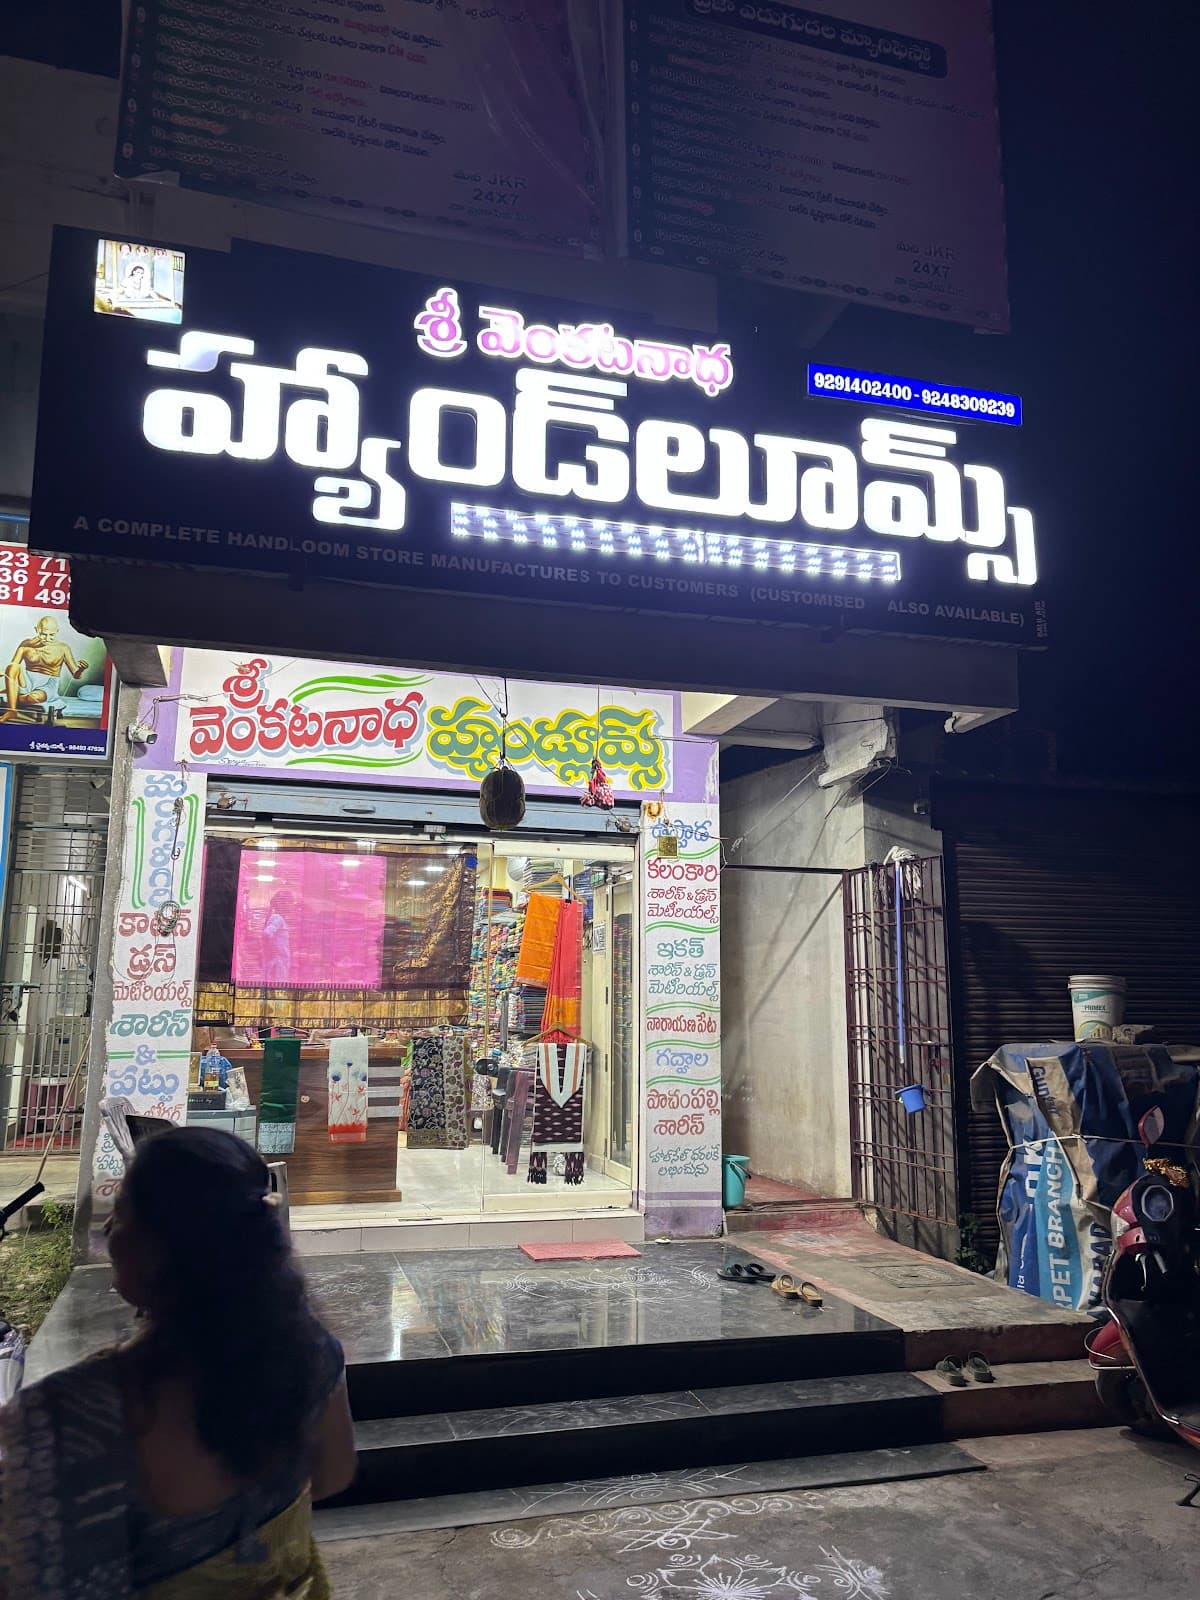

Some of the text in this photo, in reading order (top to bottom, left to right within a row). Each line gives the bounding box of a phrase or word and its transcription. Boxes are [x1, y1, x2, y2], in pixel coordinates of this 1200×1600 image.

[414, 286, 468, 358] శ్రీ
[813, 371, 912, 401] 9291402400
[921, 389, 1016, 418] 9248309239
[74, 516, 90, 531] A
[98, 518, 220, 544] COMPLETE
[227, 532, 350, 558] HANDLOOM
[356, 546, 424, 567] STORE
[431, 553, 590, 583] MANUFACTURES
[597, 571, 622, 586] TO
[628, 574, 739, 598] CUSTOMERS
[751, 586, 866, 610] (CUSTOMISED
[887, 599, 930, 615] ALSO
[935, 604, 1025, 628] AVAILABLE)
[222, 658, 268, 709] శ్రీ
[647, 857, 718, 882] కలంకారి
[687, 892, 694, 901] &
[647, 901, 719, 924] మెటీరియల్స్
[657, 937, 706, 960] ఇకత్
[684, 967, 692, 977] &
[113, 979, 193, 1007] మెటీరియల్స్
[648, 977, 720, 1001] మెటీరియల్స్
[109, 1008, 193, 1037] శారీస్
[135, 1044, 156, 1065] &
[656, 1047, 709, 1074] గద్వాల
[109, 1065, 180, 1102] పట్టు
[653, 1113, 705, 1136] శారీస్
[1046, 1146, 1064, 1249] BRANCH
